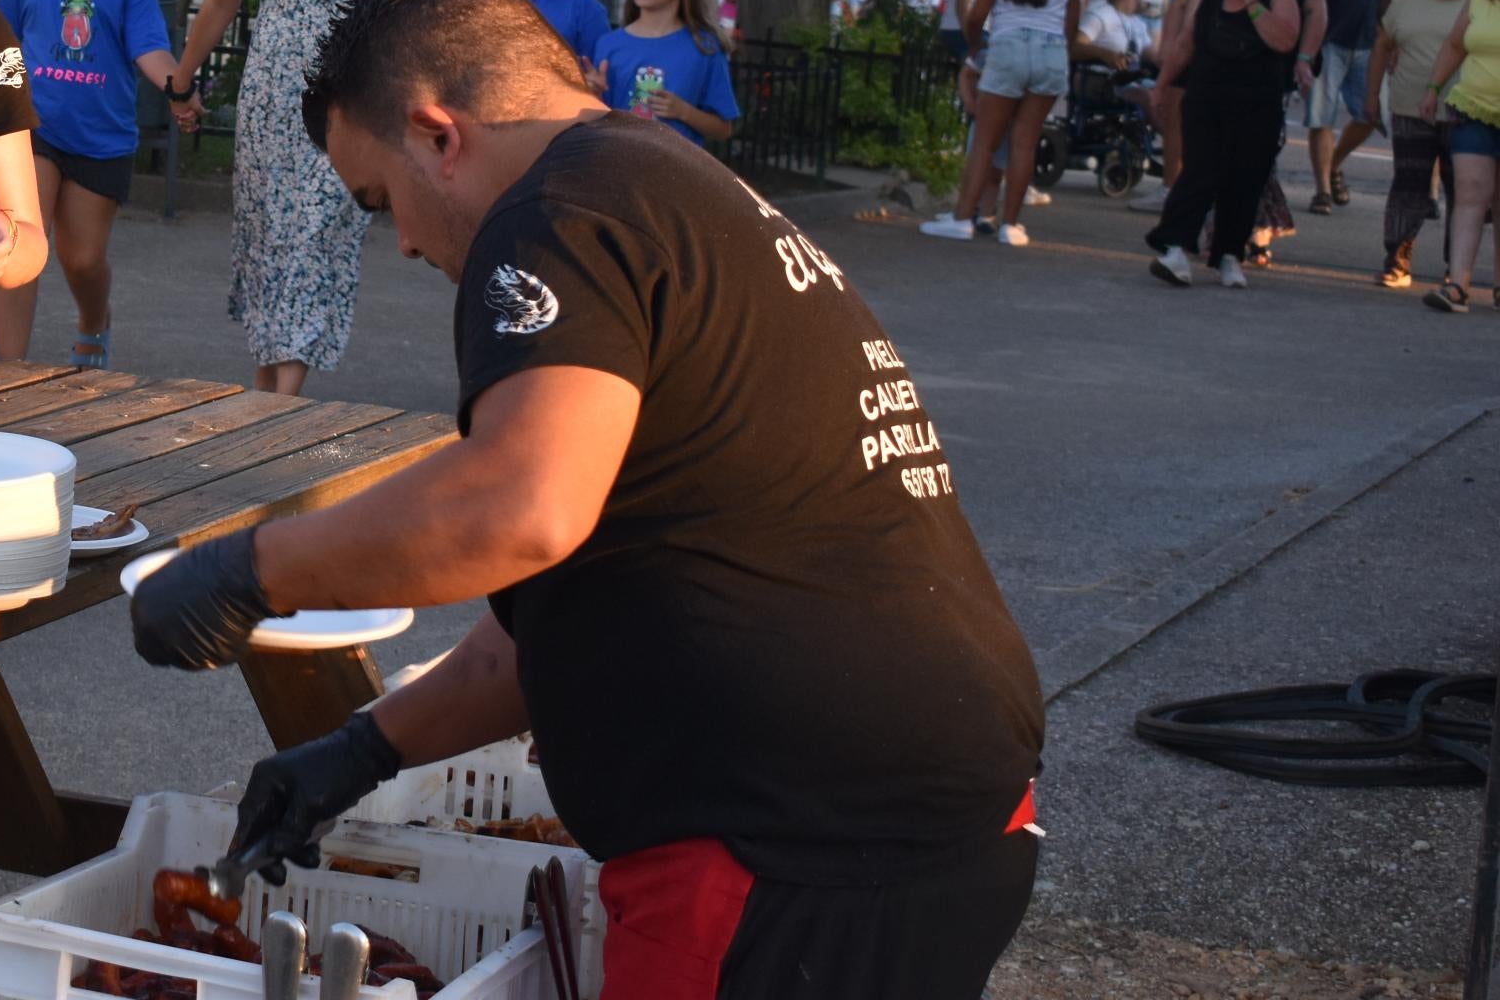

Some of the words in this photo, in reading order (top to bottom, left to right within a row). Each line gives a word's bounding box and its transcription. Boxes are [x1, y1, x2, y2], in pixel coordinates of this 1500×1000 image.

[46, 66, 106, 88] TORRES!
[775, 234, 817, 292] El
[862, 339, 905, 371] PAELL
